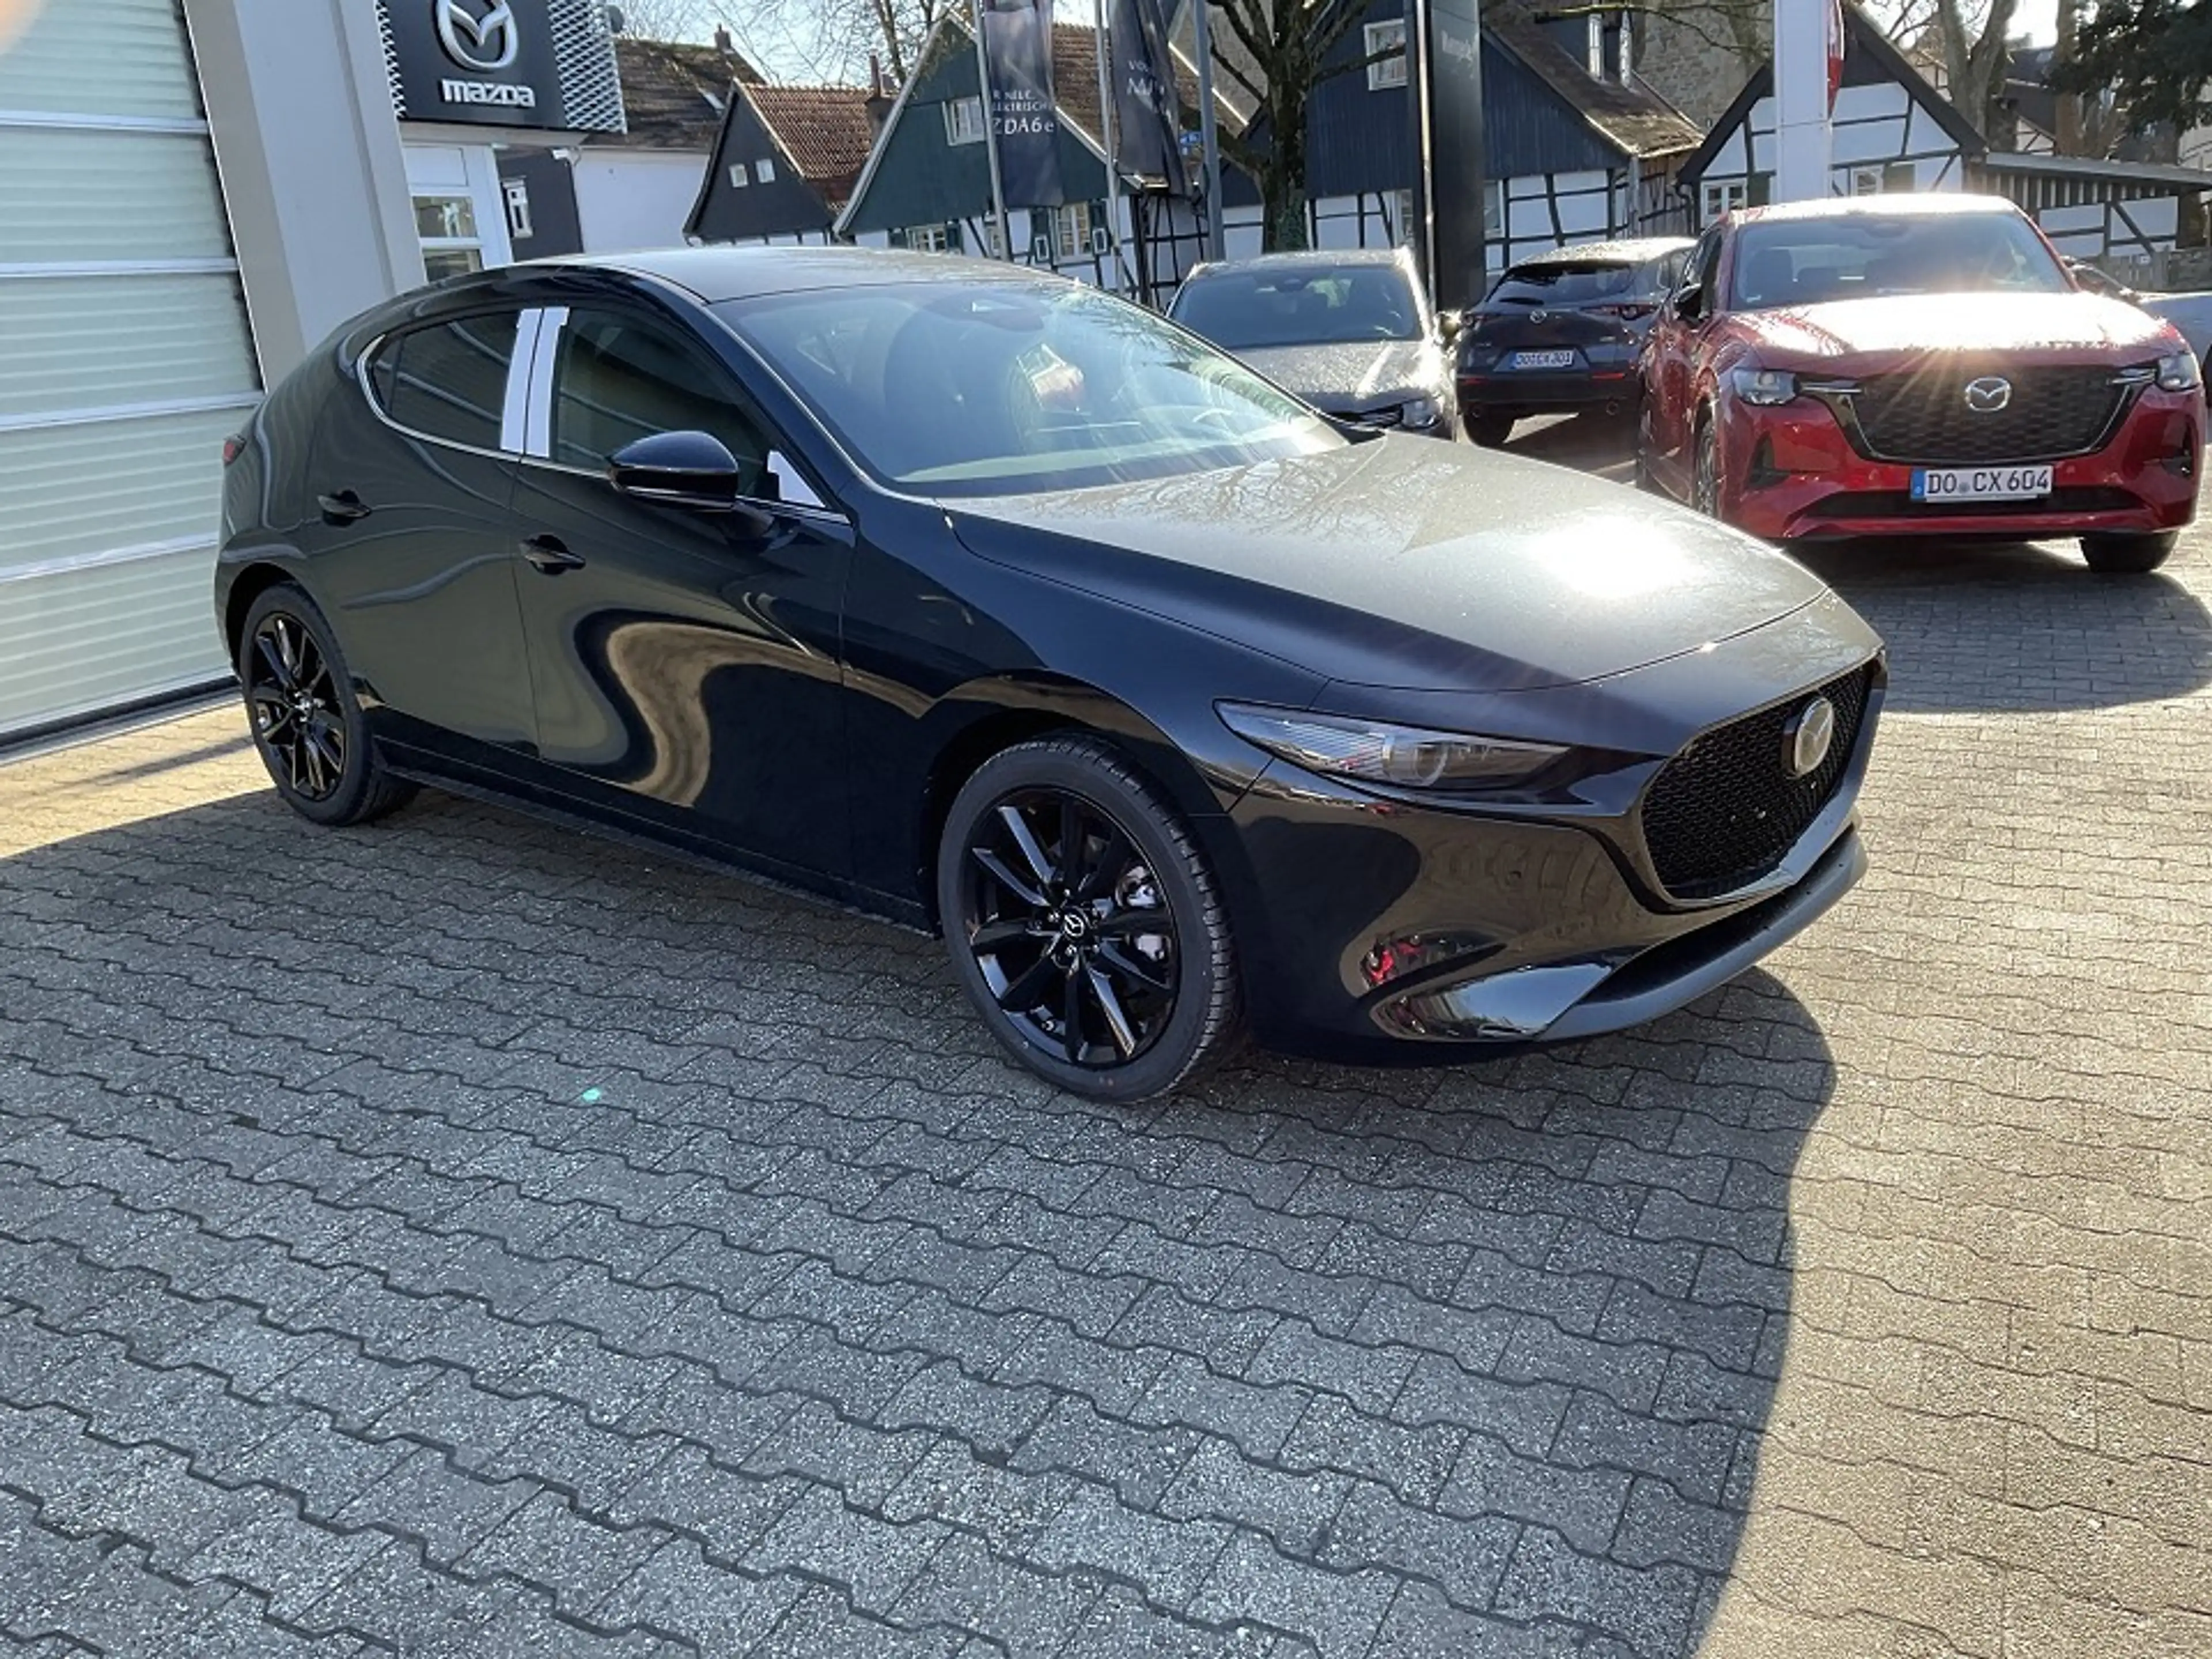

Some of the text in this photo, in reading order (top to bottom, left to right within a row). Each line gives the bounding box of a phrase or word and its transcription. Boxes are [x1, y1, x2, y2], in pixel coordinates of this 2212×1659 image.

[1927, 469, 2049, 494] DO CX 604
